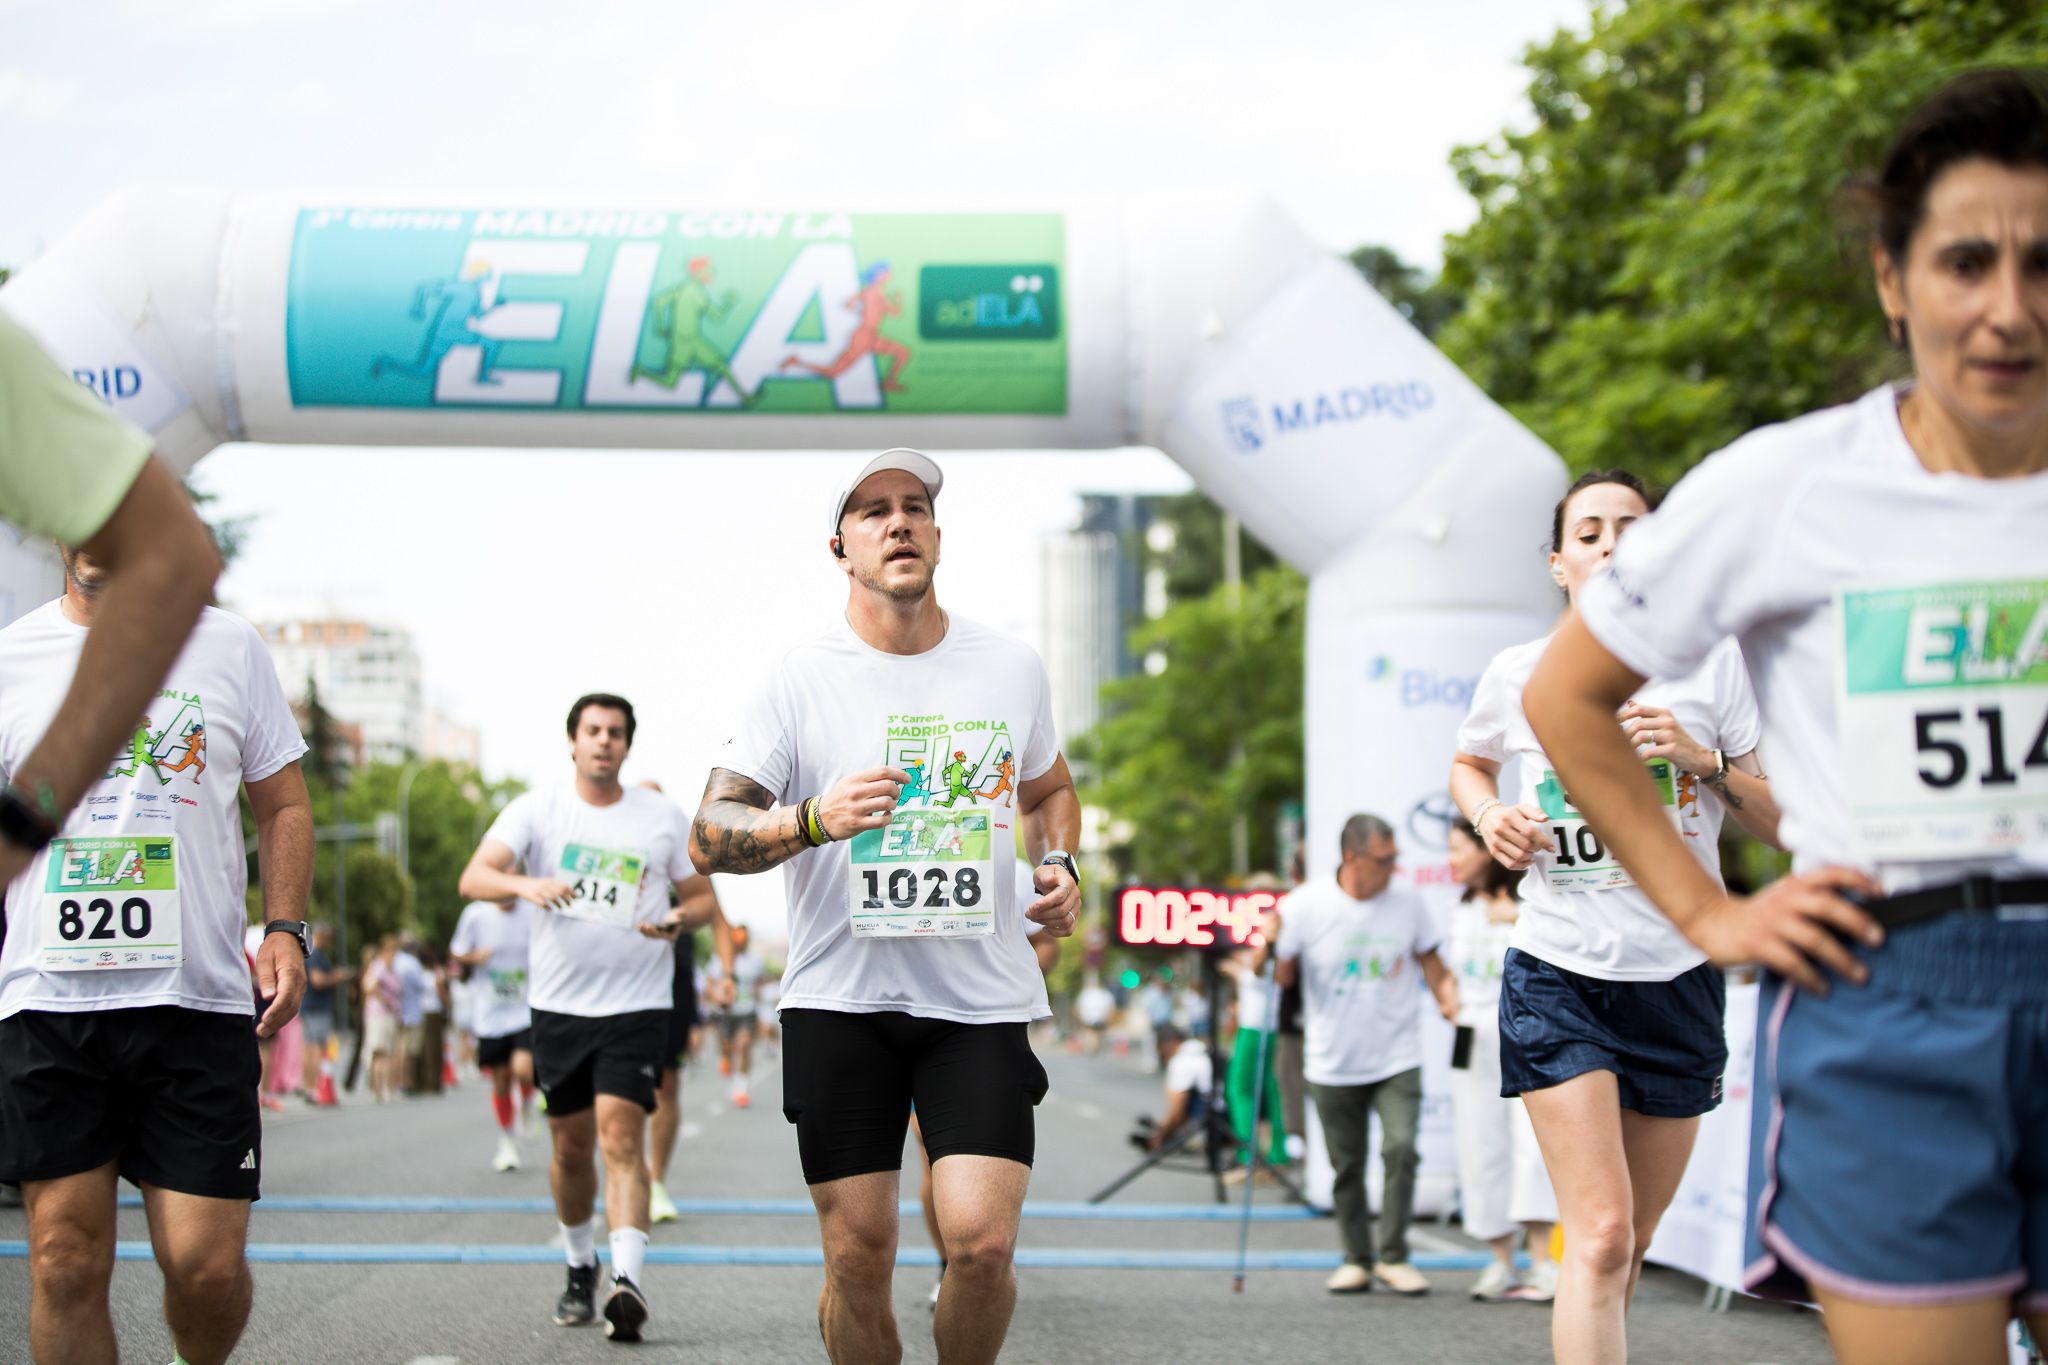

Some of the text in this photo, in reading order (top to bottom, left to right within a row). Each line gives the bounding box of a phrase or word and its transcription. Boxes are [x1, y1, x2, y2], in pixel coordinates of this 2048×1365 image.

[348, 206, 462, 229] Carrera
[472, 205, 667, 235] MADRID
[678, 209, 780, 239] CON
[791, 211, 852, 239] LA
[433, 239, 890, 407] ELA
[73, 366, 142, 405] RID
[1272, 379, 1434, 433] MADRID
[182, 692, 200, 704] LA
[887, 720, 1008, 737] MADRID CON LA
[902, 714, 944, 723] Carrera
[880, 821, 962, 857] ELA
[61, 850, 145, 887] ELA
[572, 877, 618, 906] 614
[862, 868, 982, 908] 1028
[59, 897, 152, 940] 820
[1120, 888, 1292, 948] 00245
